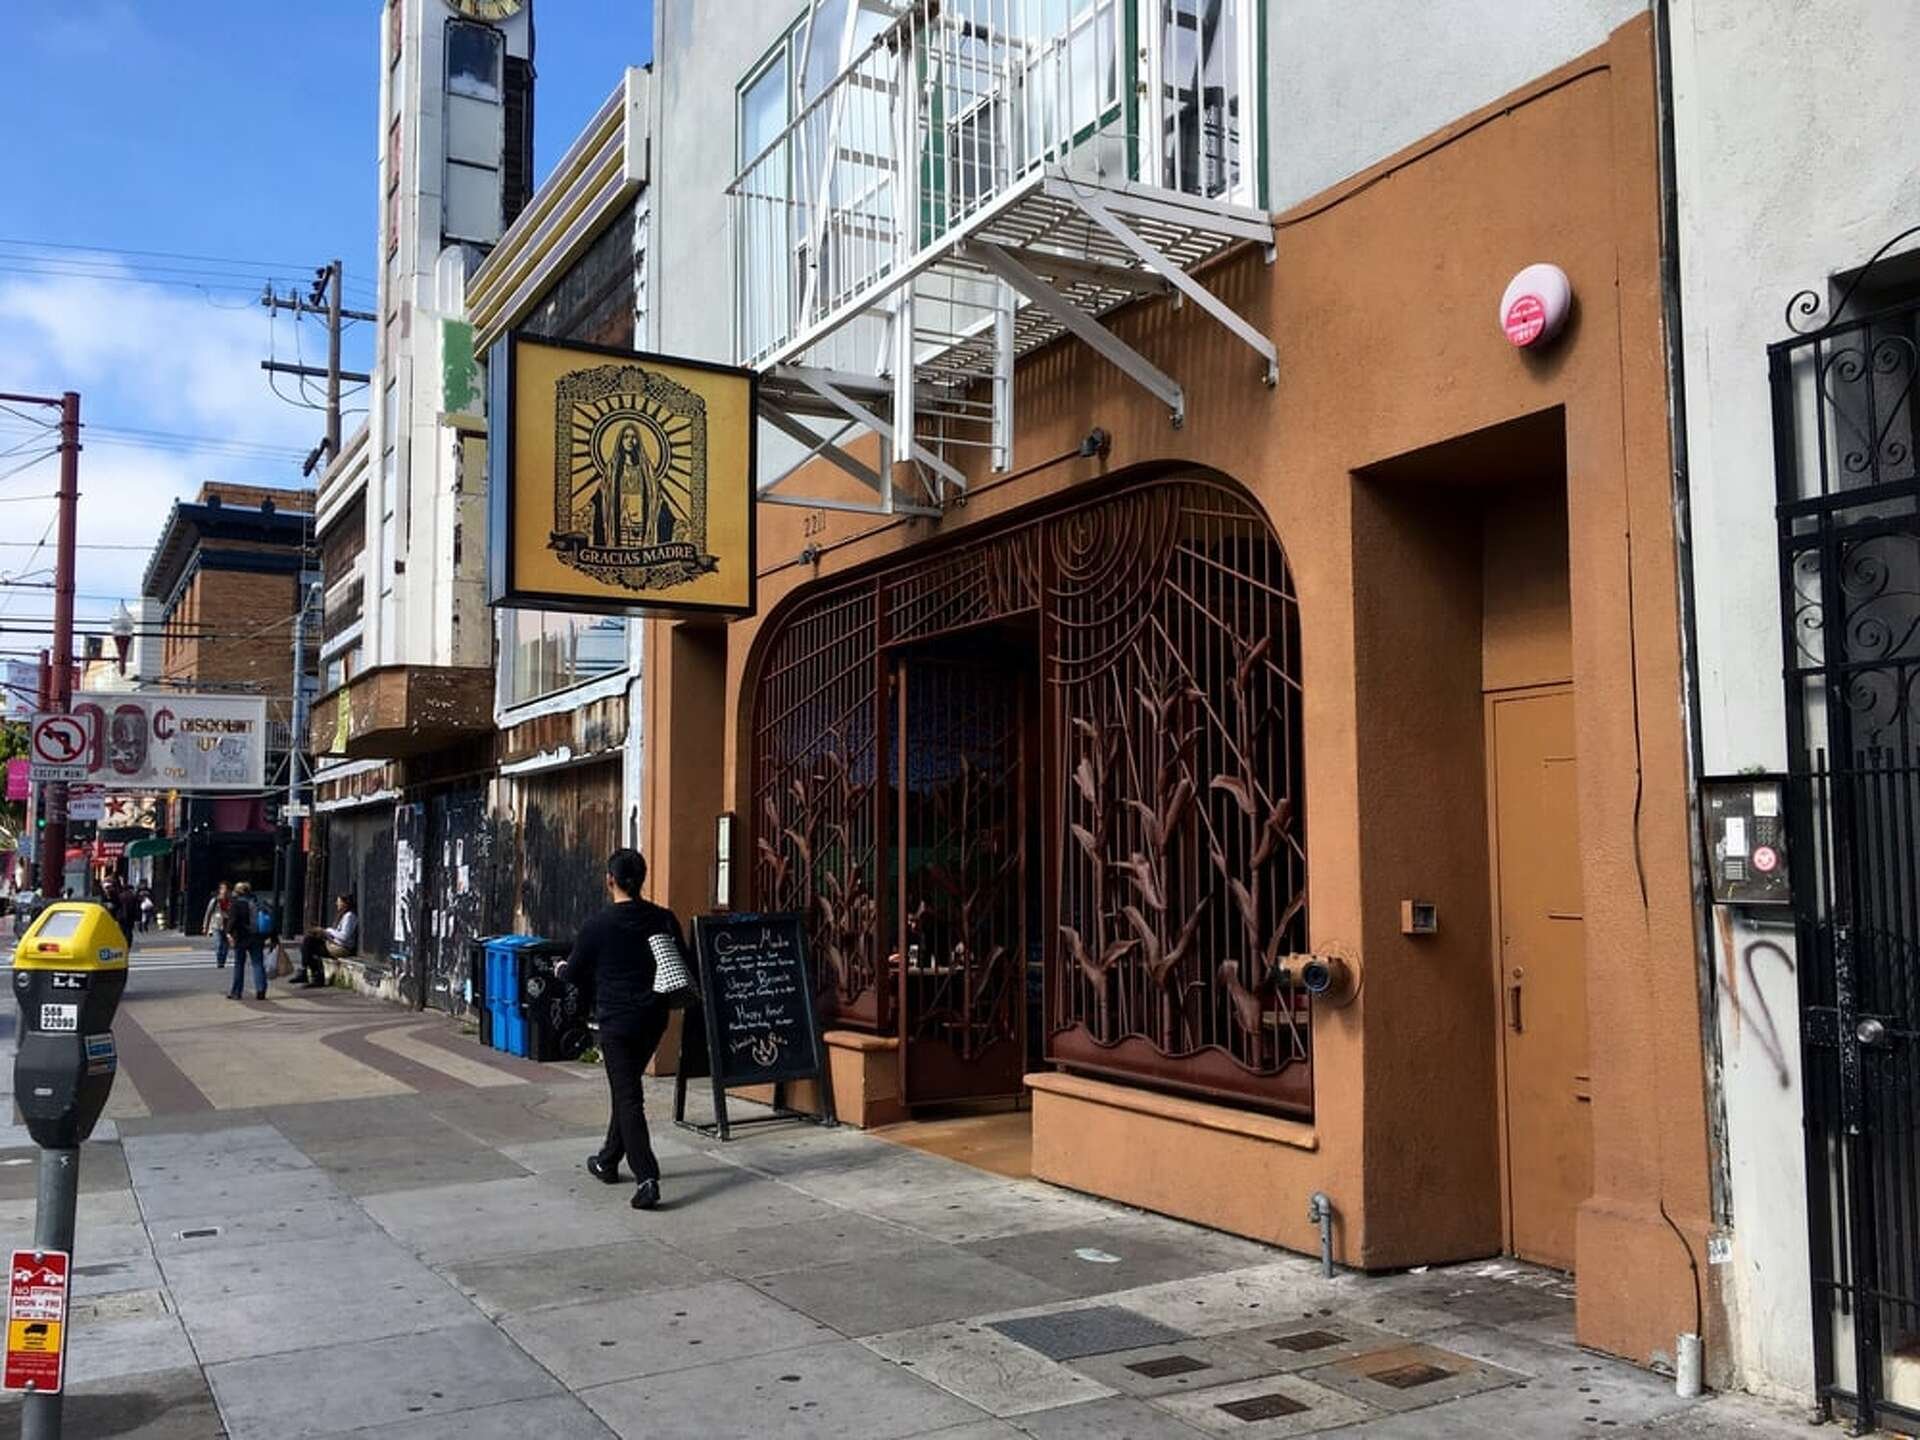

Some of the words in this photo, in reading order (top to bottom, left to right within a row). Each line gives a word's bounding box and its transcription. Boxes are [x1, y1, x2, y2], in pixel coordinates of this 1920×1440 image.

[579, 549, 640, 565] GRACIAS
[643, 546, 695, 563] MADRE
[180, 717, 255, 734] DISCOUNT
[14, 1286, 30, 1296] NO
[15, 1299, 36, 1307] MON
